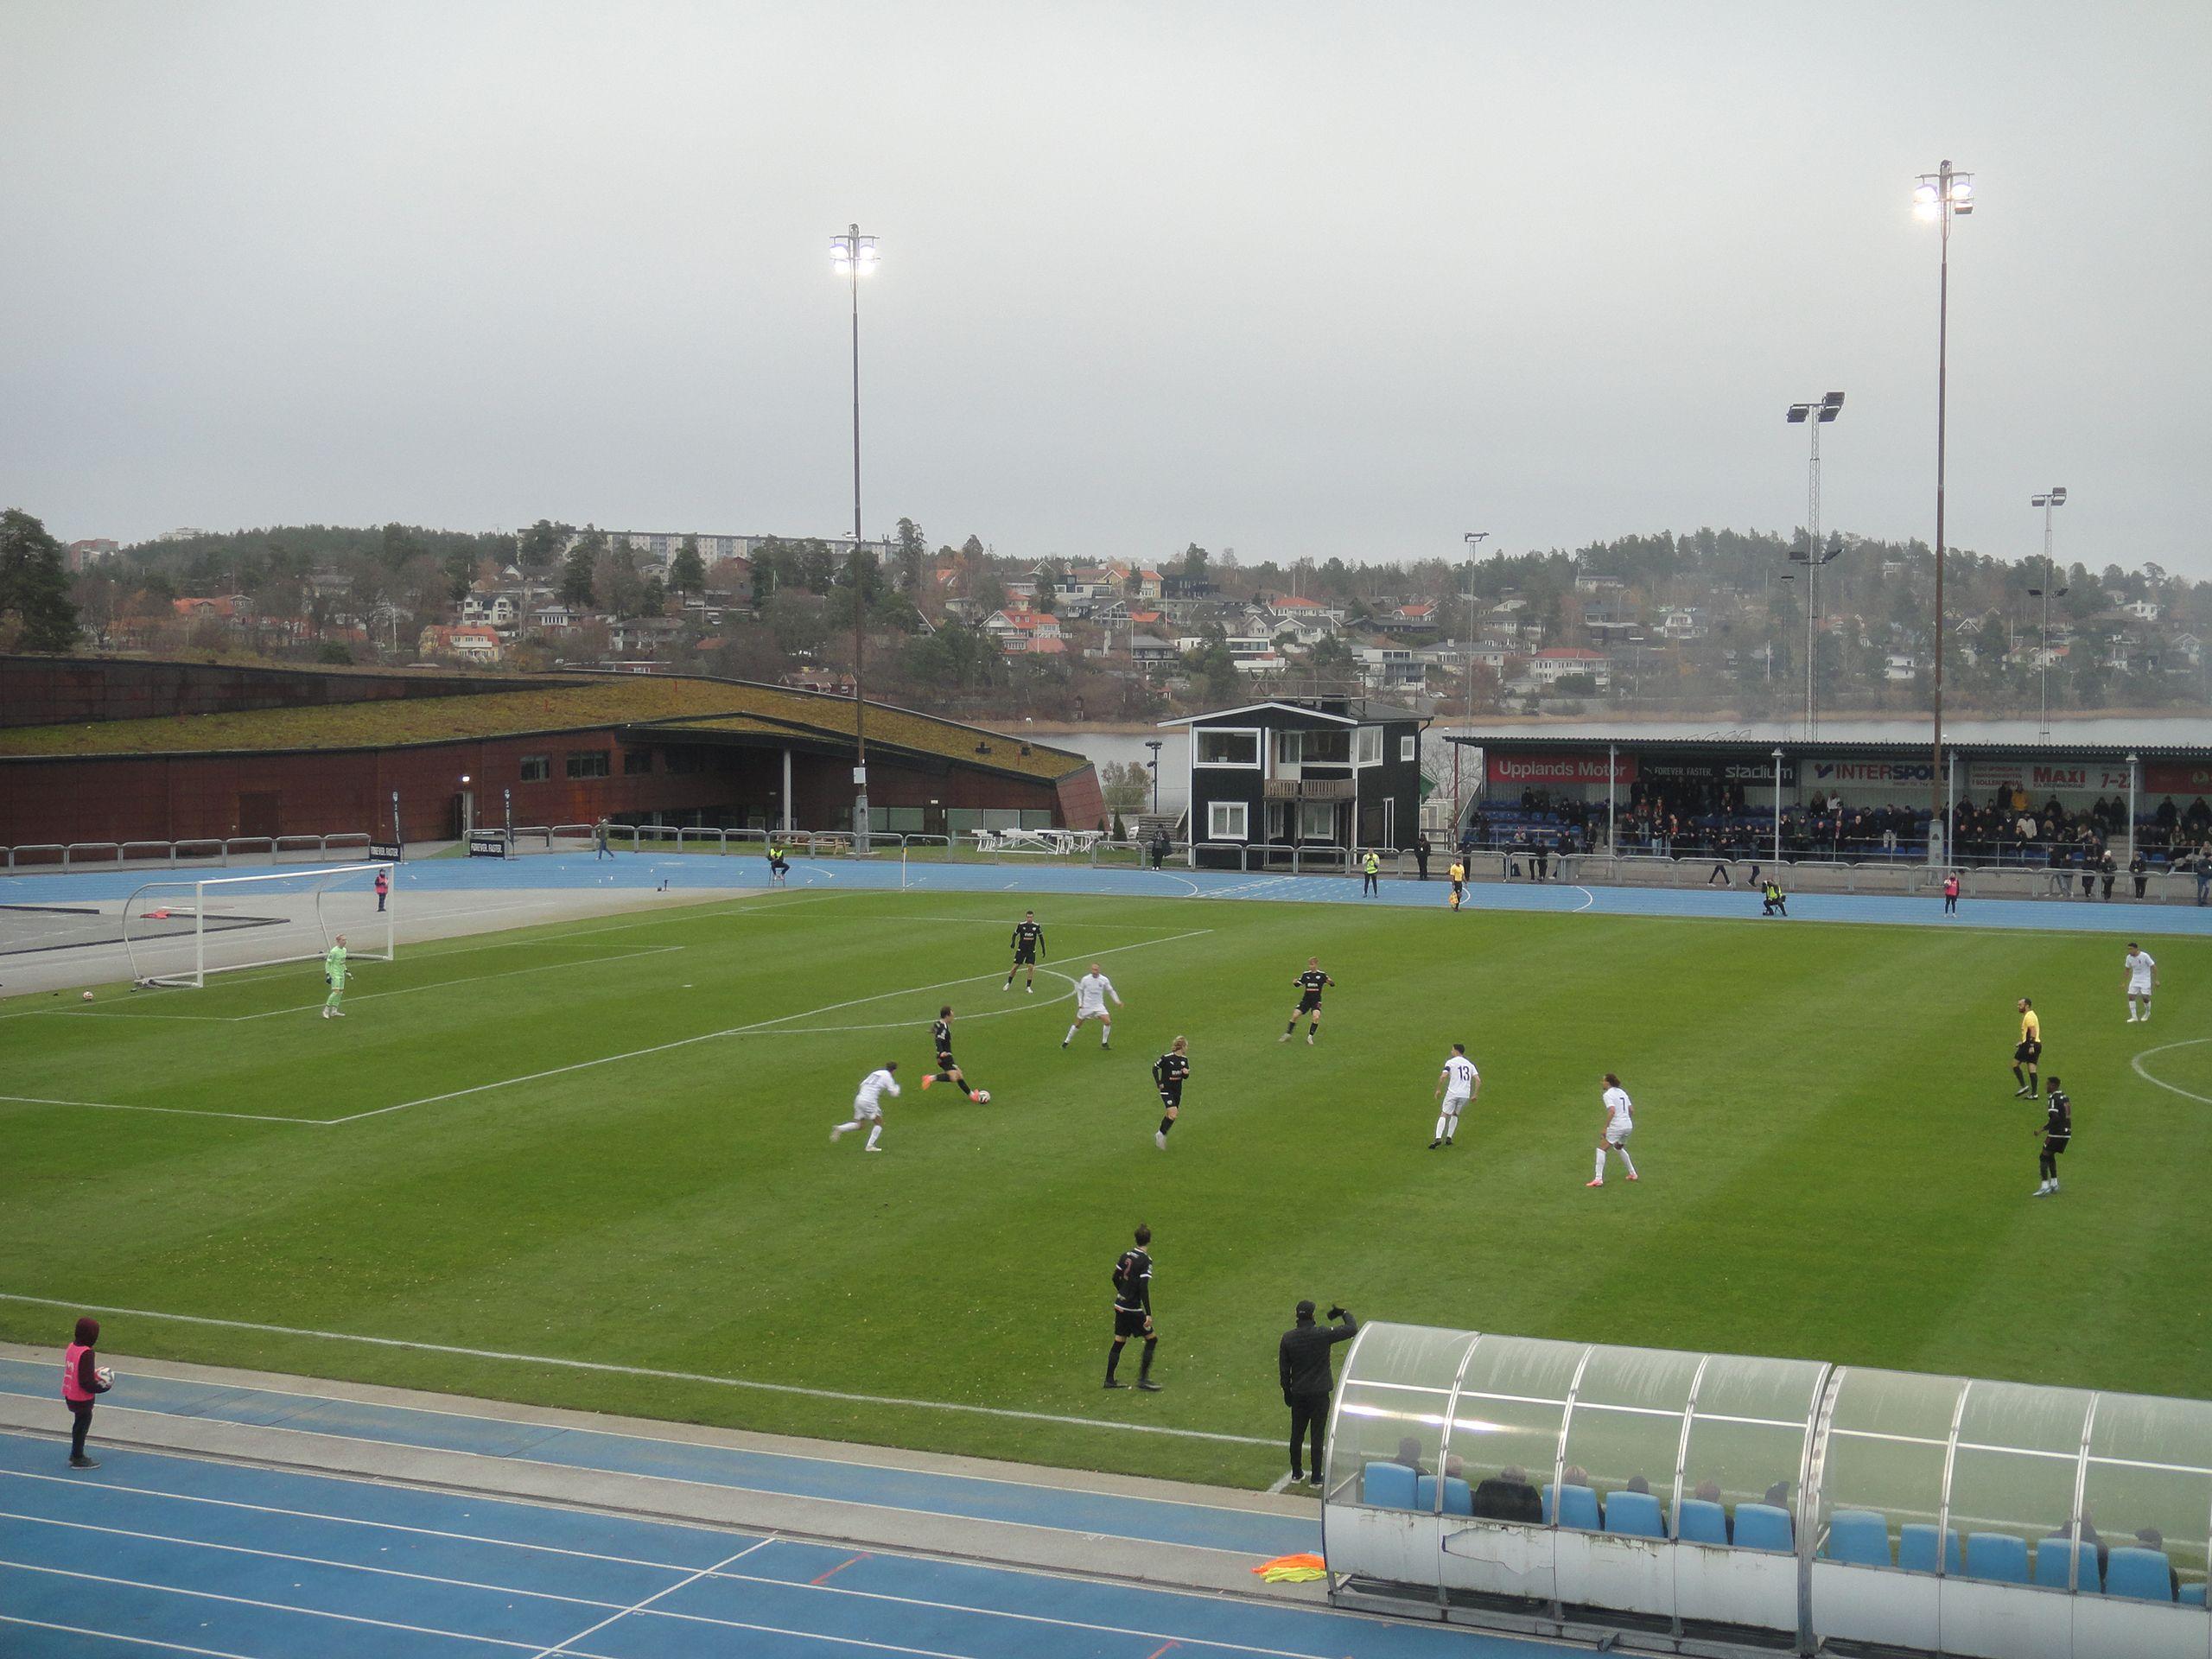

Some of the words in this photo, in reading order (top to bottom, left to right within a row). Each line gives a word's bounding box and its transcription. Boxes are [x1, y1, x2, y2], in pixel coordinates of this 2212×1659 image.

[1499, 760, 1575, 779] Upplands
[1579, 760, 1626, 777] Motor
[1725, 764, 1794, 779] stadium
[2033, 766, 2086, 783] MAXI
[1457, 1065, 1470, 1081] 13
[1619, 1096, 1626, 1111] 7
